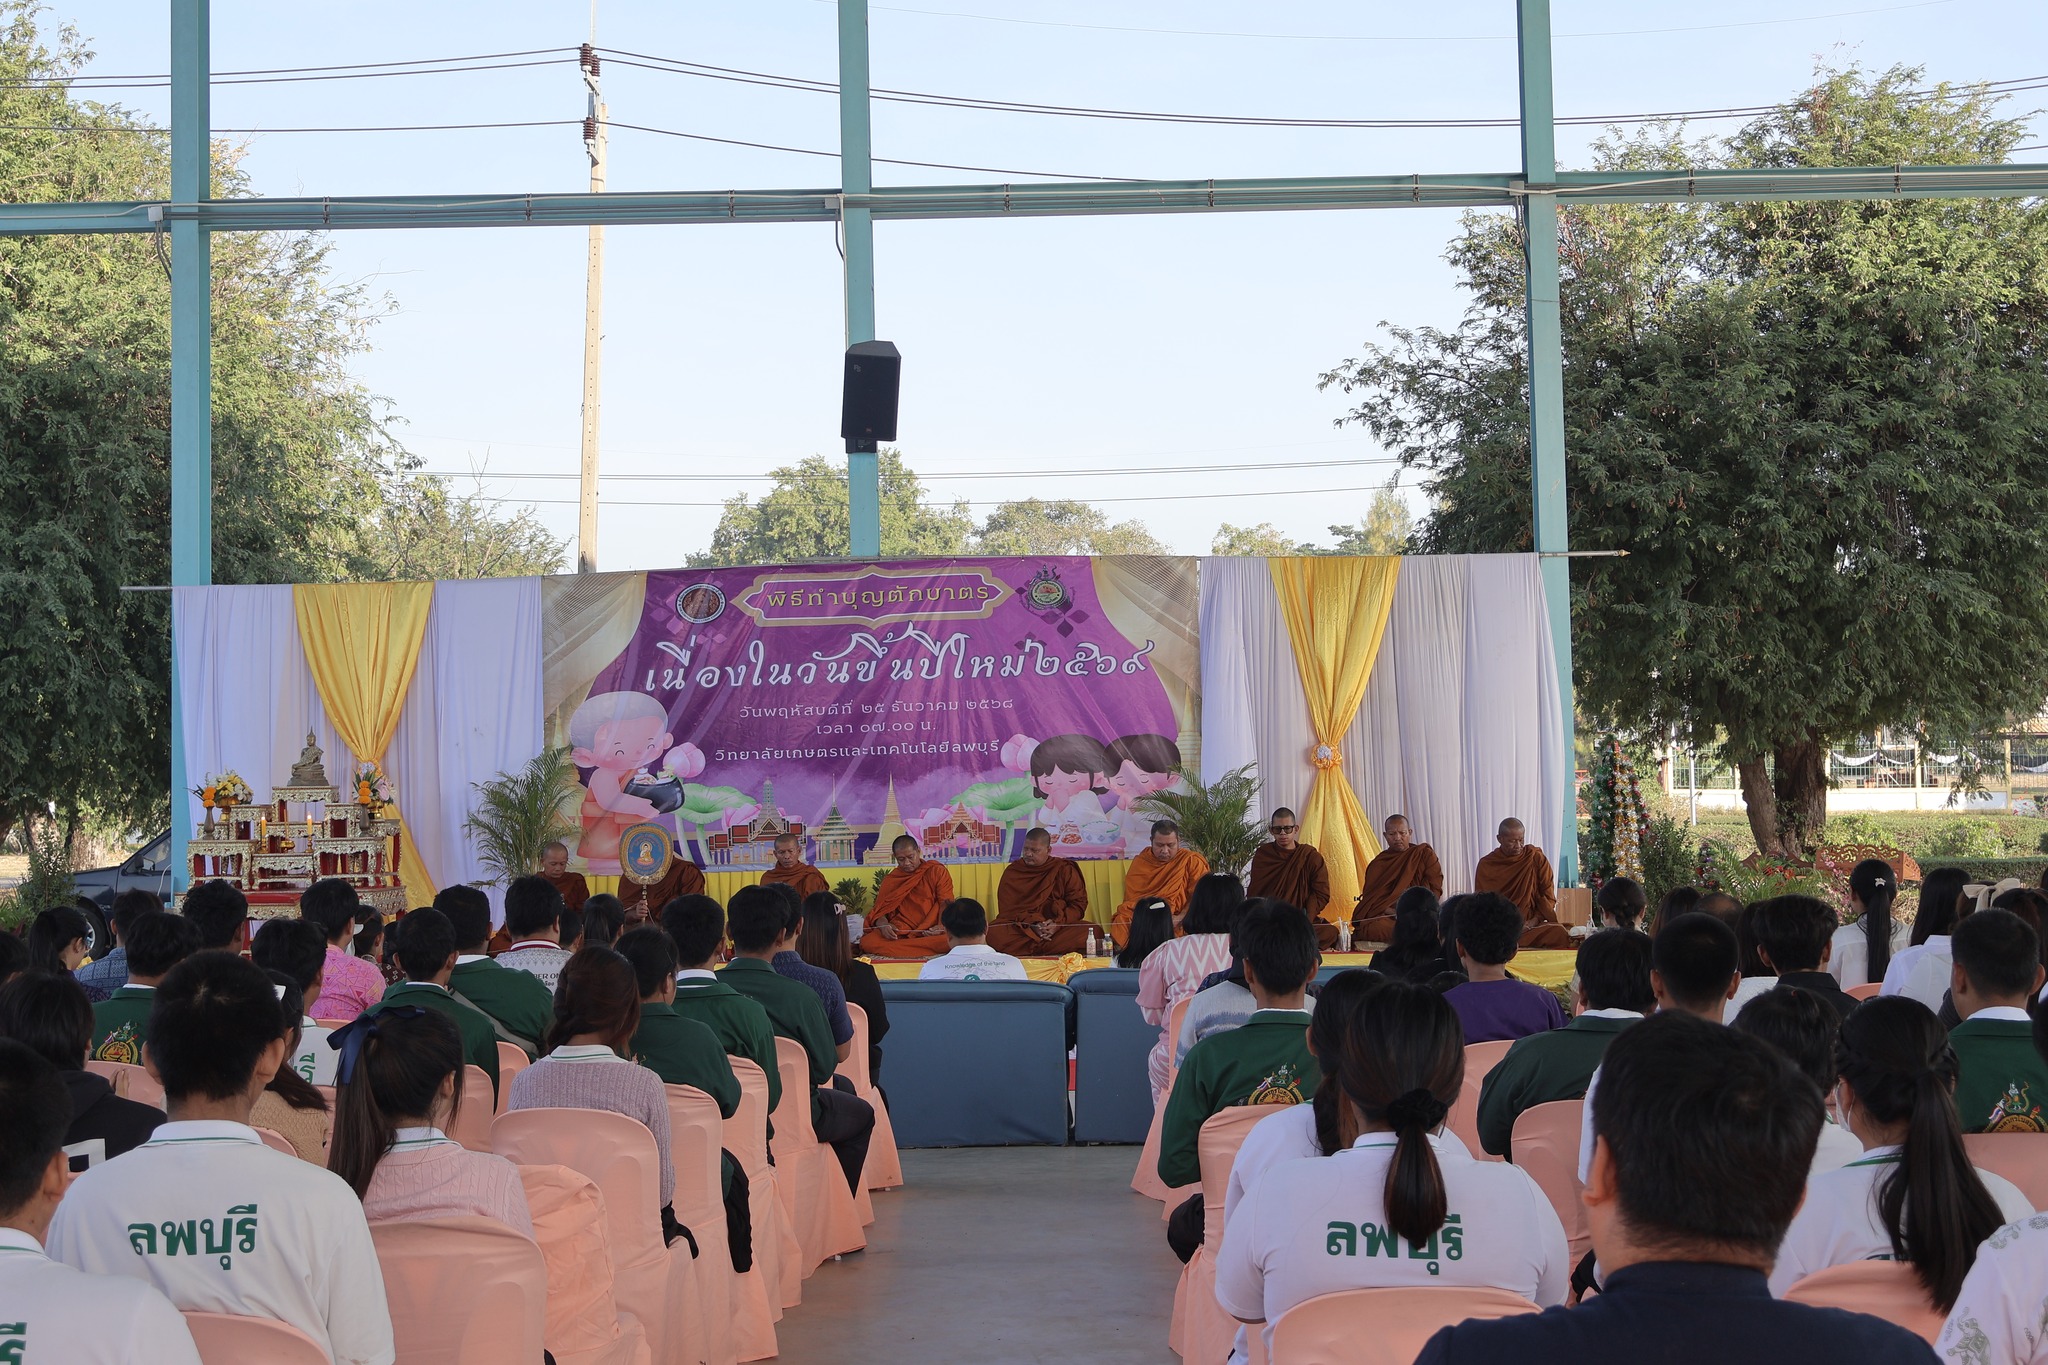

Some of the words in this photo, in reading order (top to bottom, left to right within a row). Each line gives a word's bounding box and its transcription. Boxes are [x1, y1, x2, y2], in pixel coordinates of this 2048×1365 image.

[766, 585, 989, 611] พิธีทำบุญตักบาตร
[739, 699, 854, 719] วันพฤหัสบดีที่
[861, 702, 885, 714] ๒๕
[891, 700, 959, 713] ธันวาคม
[966, 698, 1014, 710] ๒๕๖๘
[816, 724, 854, 735] เวลา
[860, 721, 914, 733] ๐๗.๐๐
[921, 720, 936, 731] น.
[715, 739, 1000, 761] วิทยาลัยเกษตรและเทคโนโลยีลพบุรี
[127, 1203, 258, 1271] ลพบุรี
